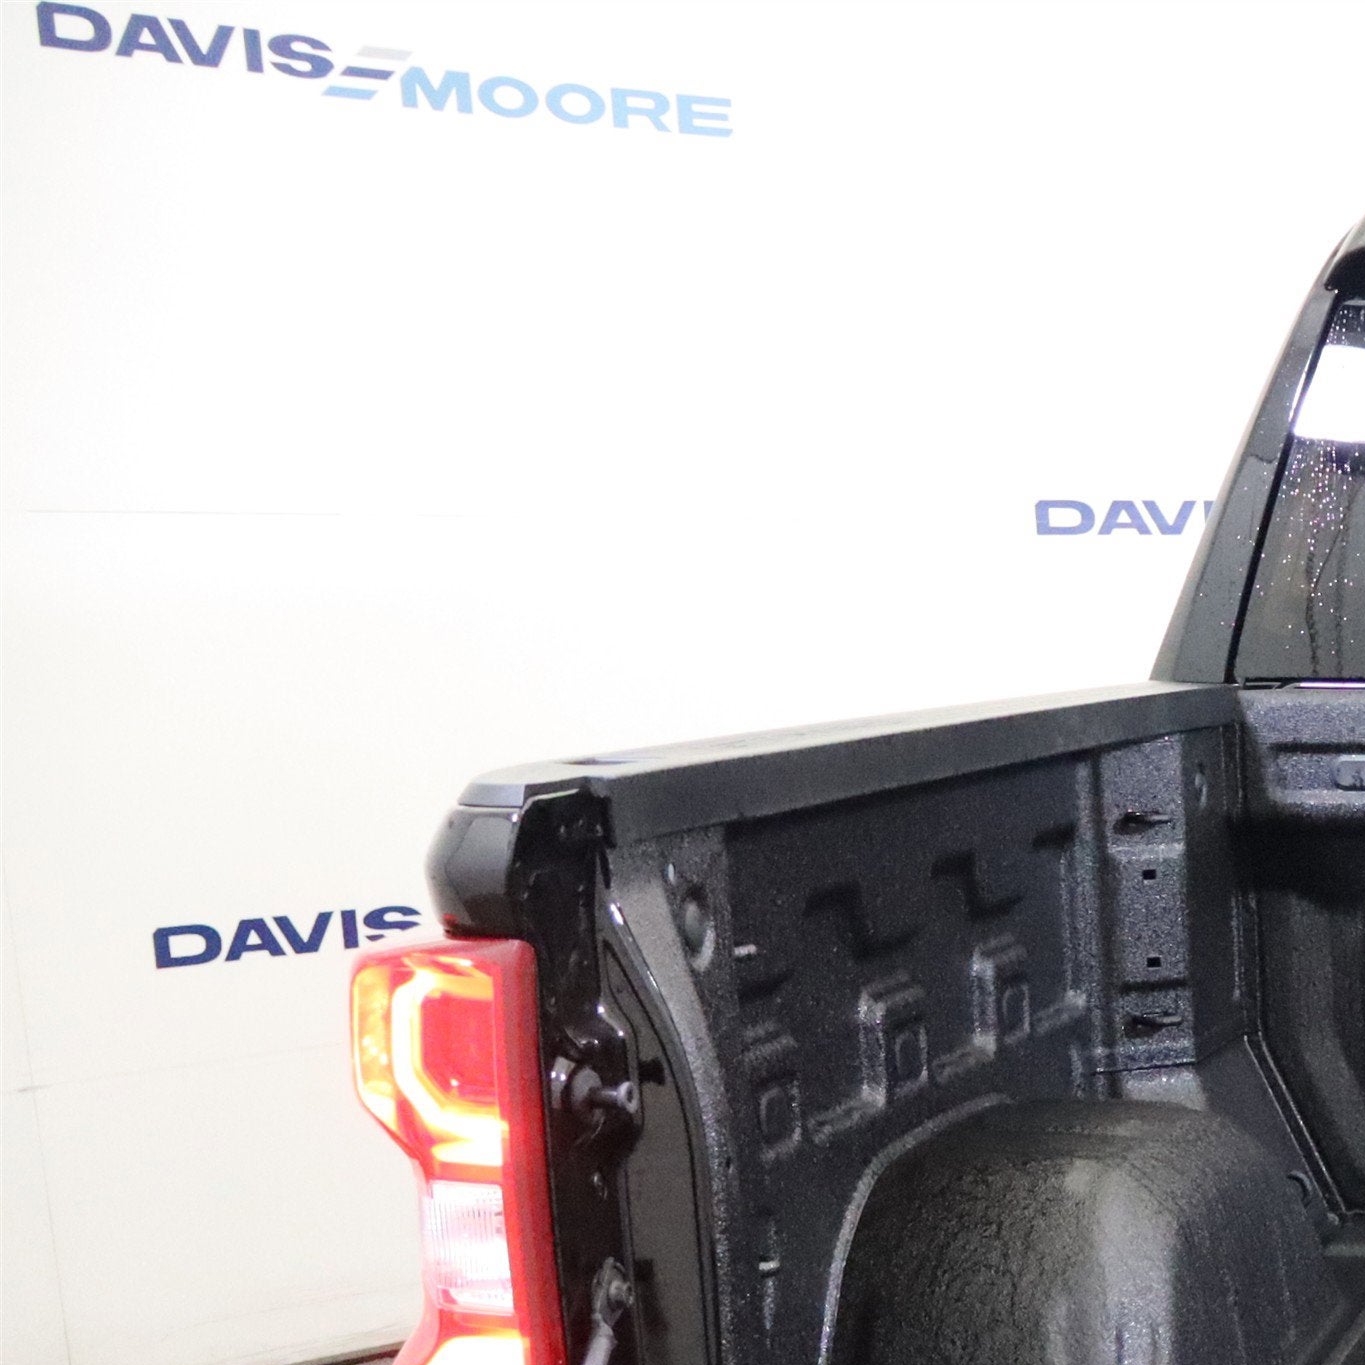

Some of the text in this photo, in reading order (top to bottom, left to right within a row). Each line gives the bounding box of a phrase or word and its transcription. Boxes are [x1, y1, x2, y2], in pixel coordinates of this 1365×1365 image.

[37, 1, 733, 137] DAVIS MOORE
[1034, 500, 1217, 535] DAV
[152, 905, 423, 969] DAVIS
